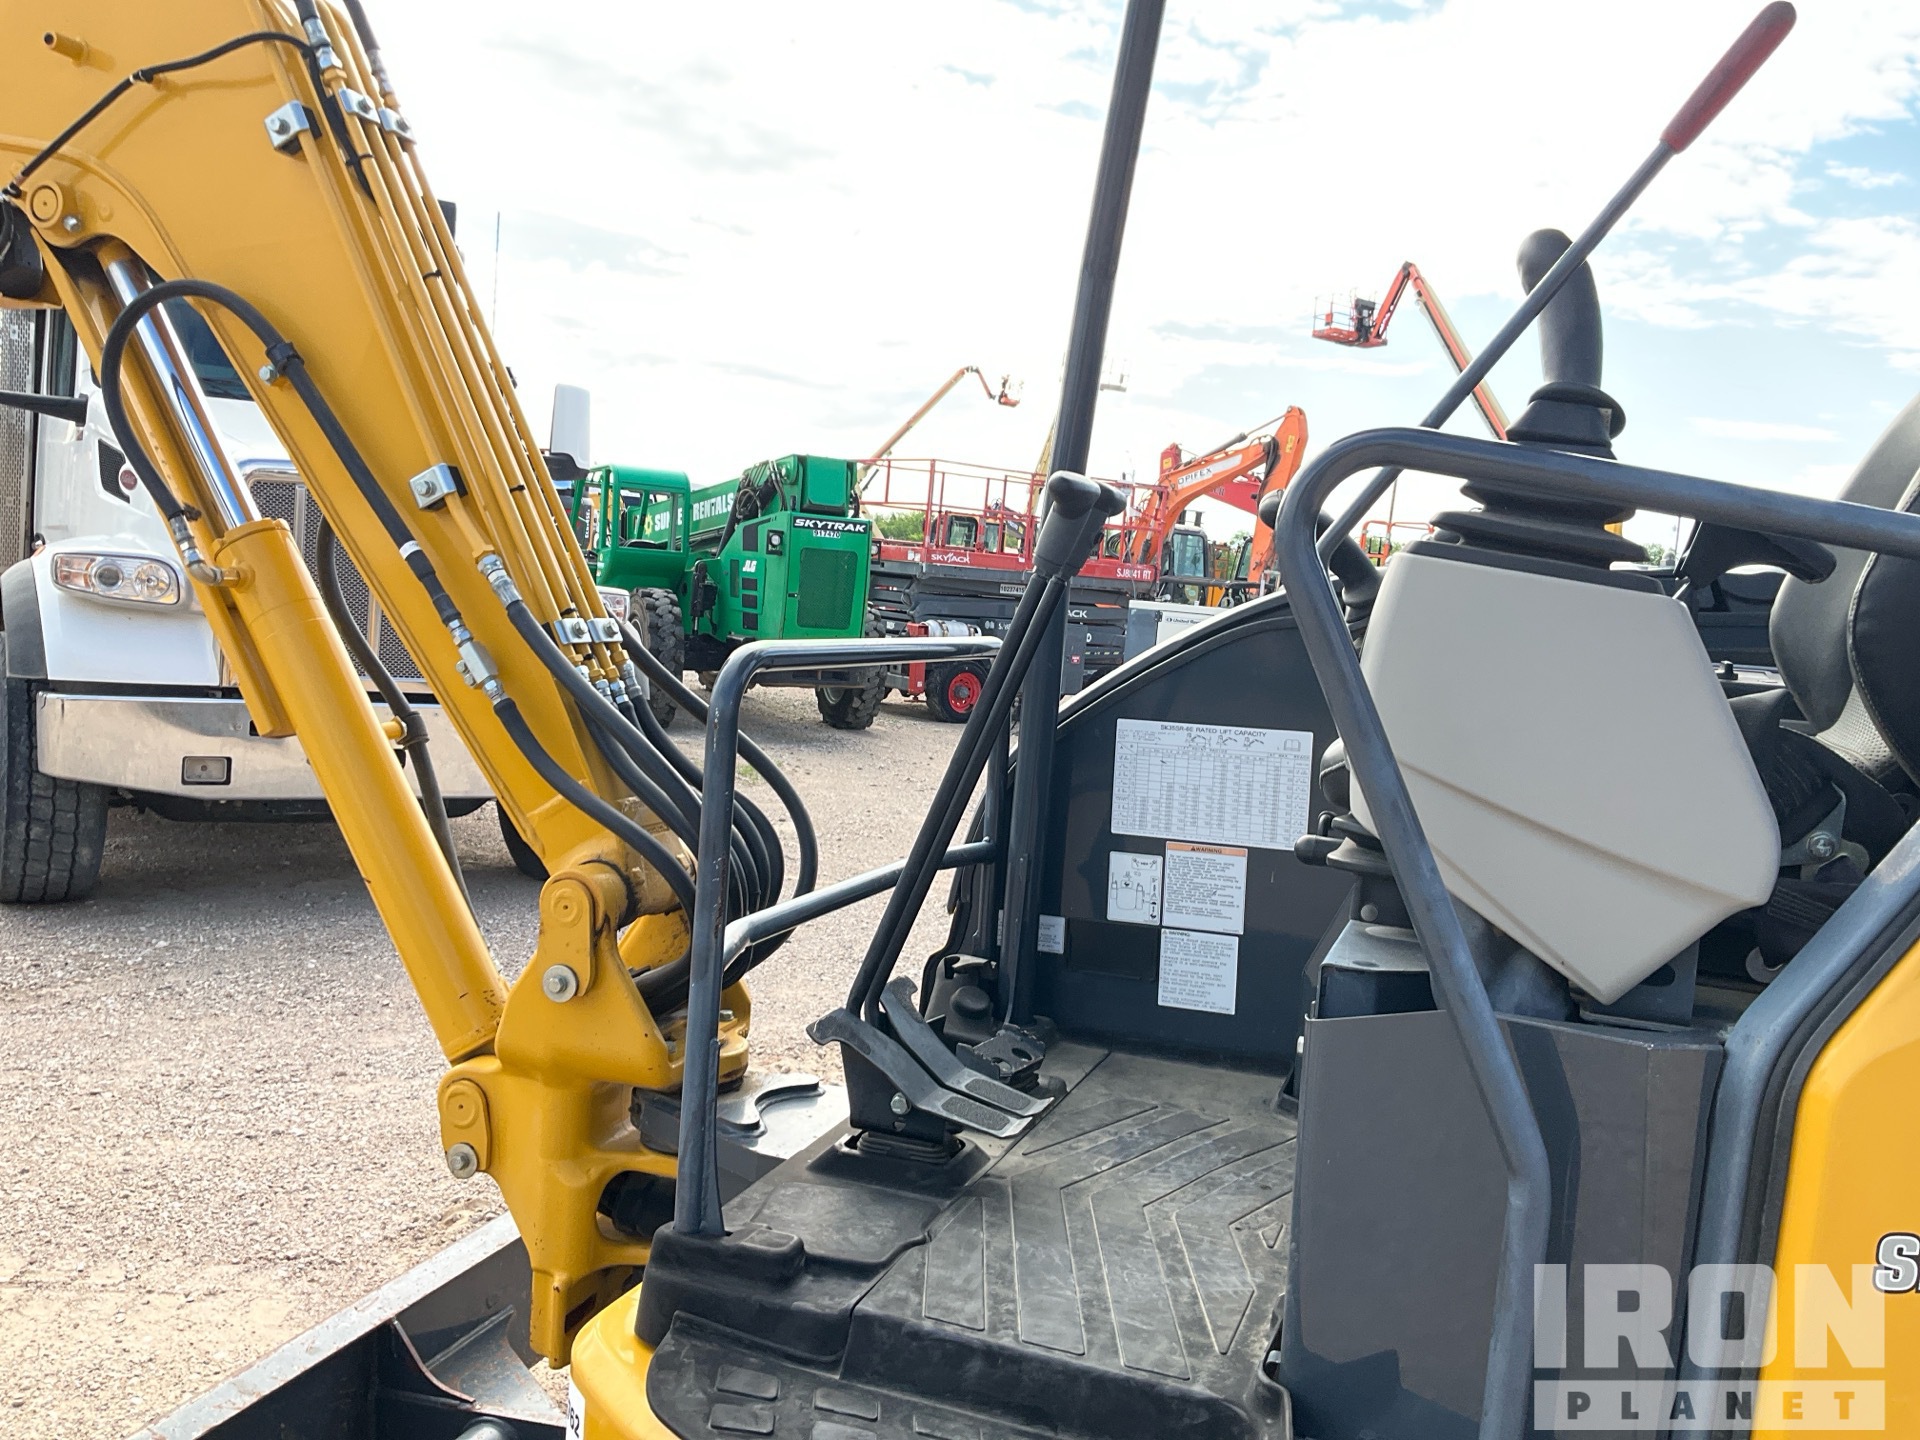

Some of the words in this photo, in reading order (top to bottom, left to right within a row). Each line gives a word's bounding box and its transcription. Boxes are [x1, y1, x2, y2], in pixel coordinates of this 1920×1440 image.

[693, 492, 734, 521] RENTALS
[794, 518, 866, 532] SKYTRAK
[931, 552, 970, 564] SKYJACK
[743, 560, 757, 573] JLG
[1235, 730, 1267, 738] CAPACITY
[1872, 1232, 1920, 1293] S
